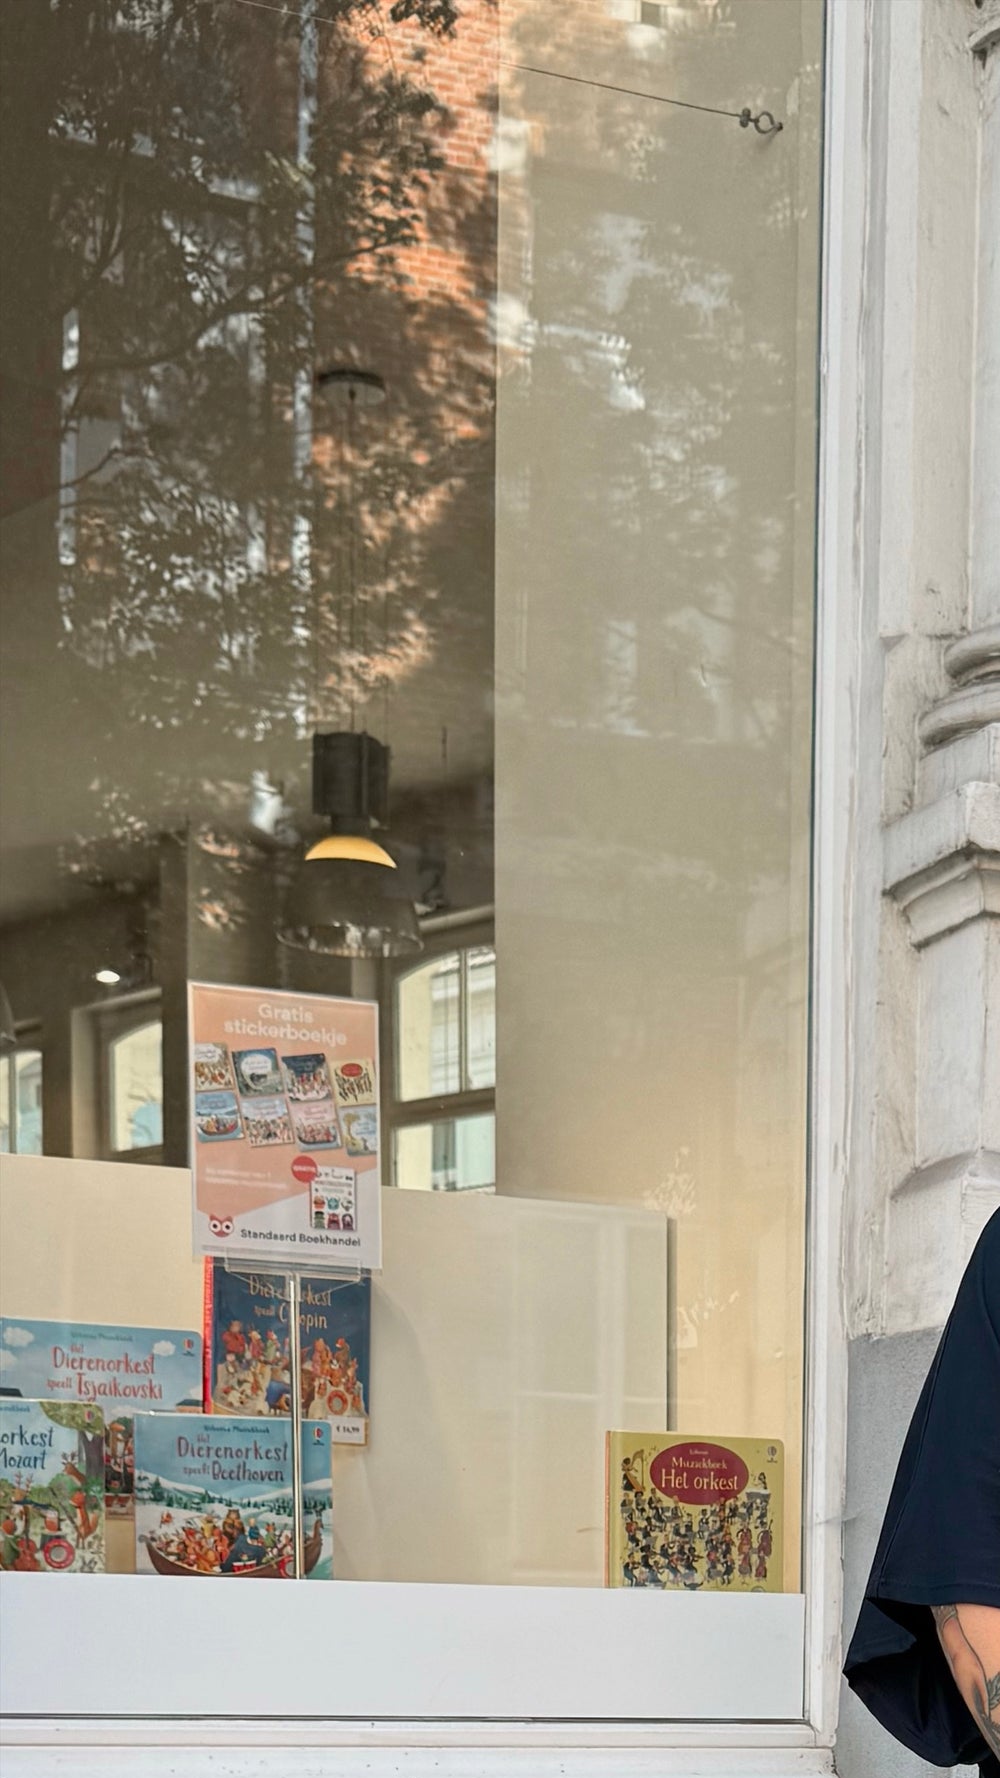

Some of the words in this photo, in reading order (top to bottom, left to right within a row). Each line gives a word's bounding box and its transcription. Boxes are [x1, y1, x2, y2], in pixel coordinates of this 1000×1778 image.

[258, 1003, 314, 1024] Gratis
[224, 1019, 347, 1047] stickerboekje
[240, 1229, 296, 1243] Standaard
[299, 1233, 361, 1247] Boekhandel
[279, 1302, 328, 1334] Copin
[53, 1346, 155, 1374] Dierenorkest
[77, 1372, 163, 1402] Tsjaikovski
[0, 1424, 53, 1448] orkest
[177, 1436, 288, 1461] Dierenorkest
[211, 1460, 285, 1482] Beethoven
[661, 1468, 689, 1489] Het
[694, 1471, 738, 1491] orkest
